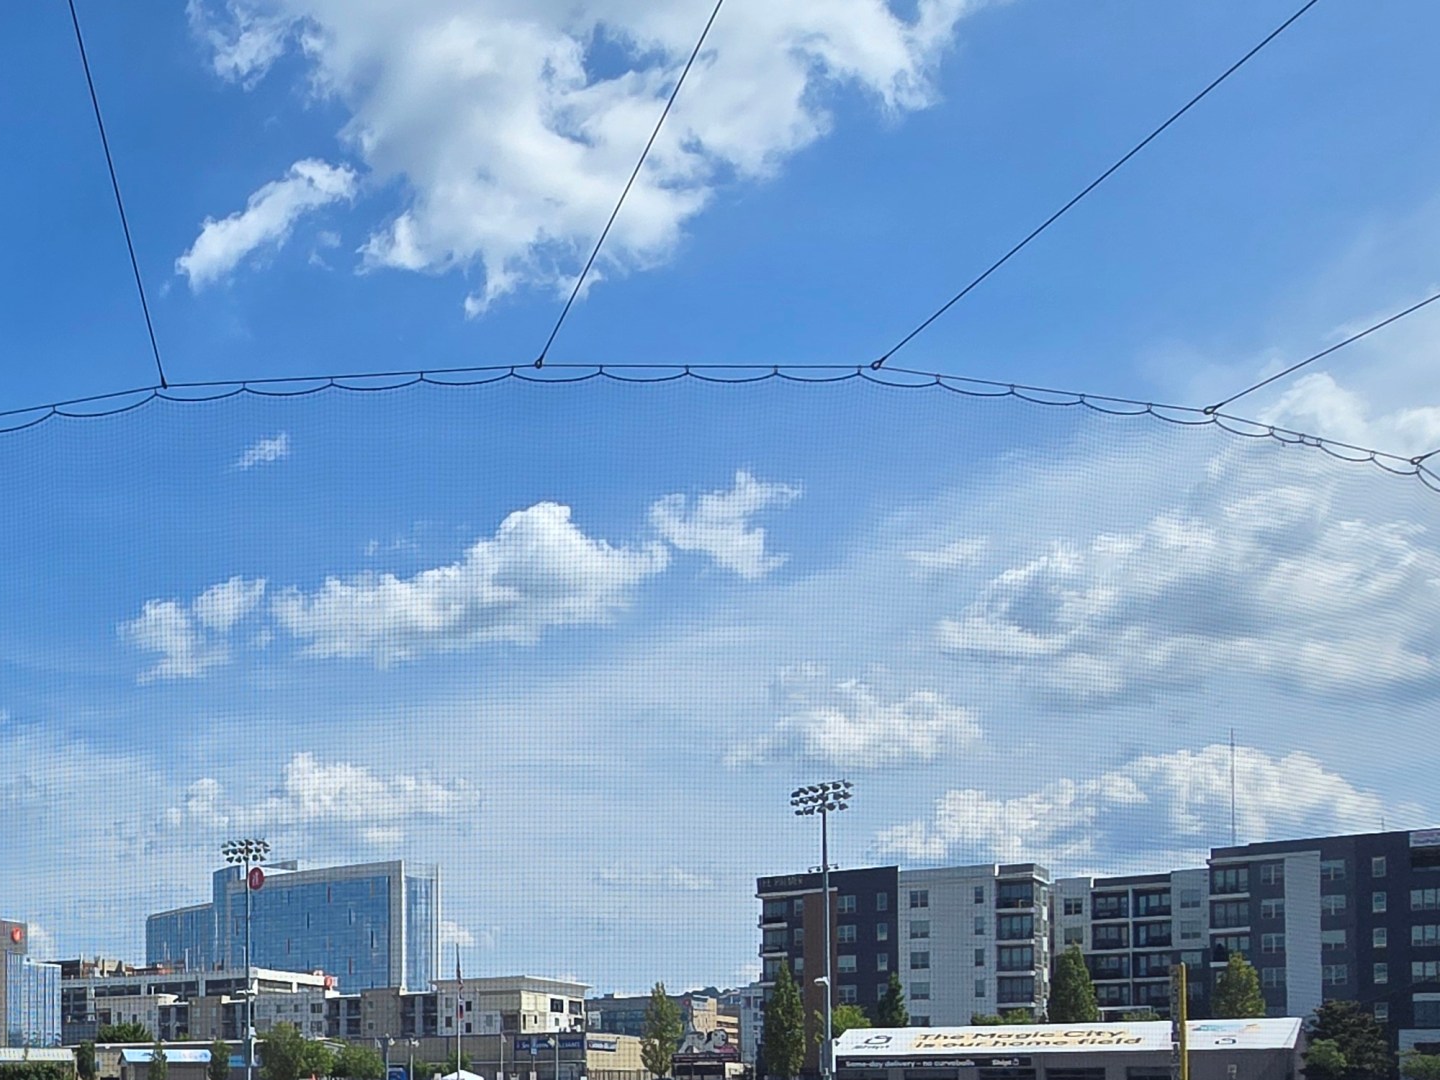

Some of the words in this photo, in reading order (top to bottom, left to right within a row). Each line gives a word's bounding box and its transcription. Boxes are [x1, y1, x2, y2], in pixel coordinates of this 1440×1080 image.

[919, 1033, 966, 1041] The
[971, 1031, 1055, 1041] Magic
[1063, 1030, 1125, 1039] City
[991, 1039, 1068, 1047] home
[1076, 1037, 1143, 1045] field
